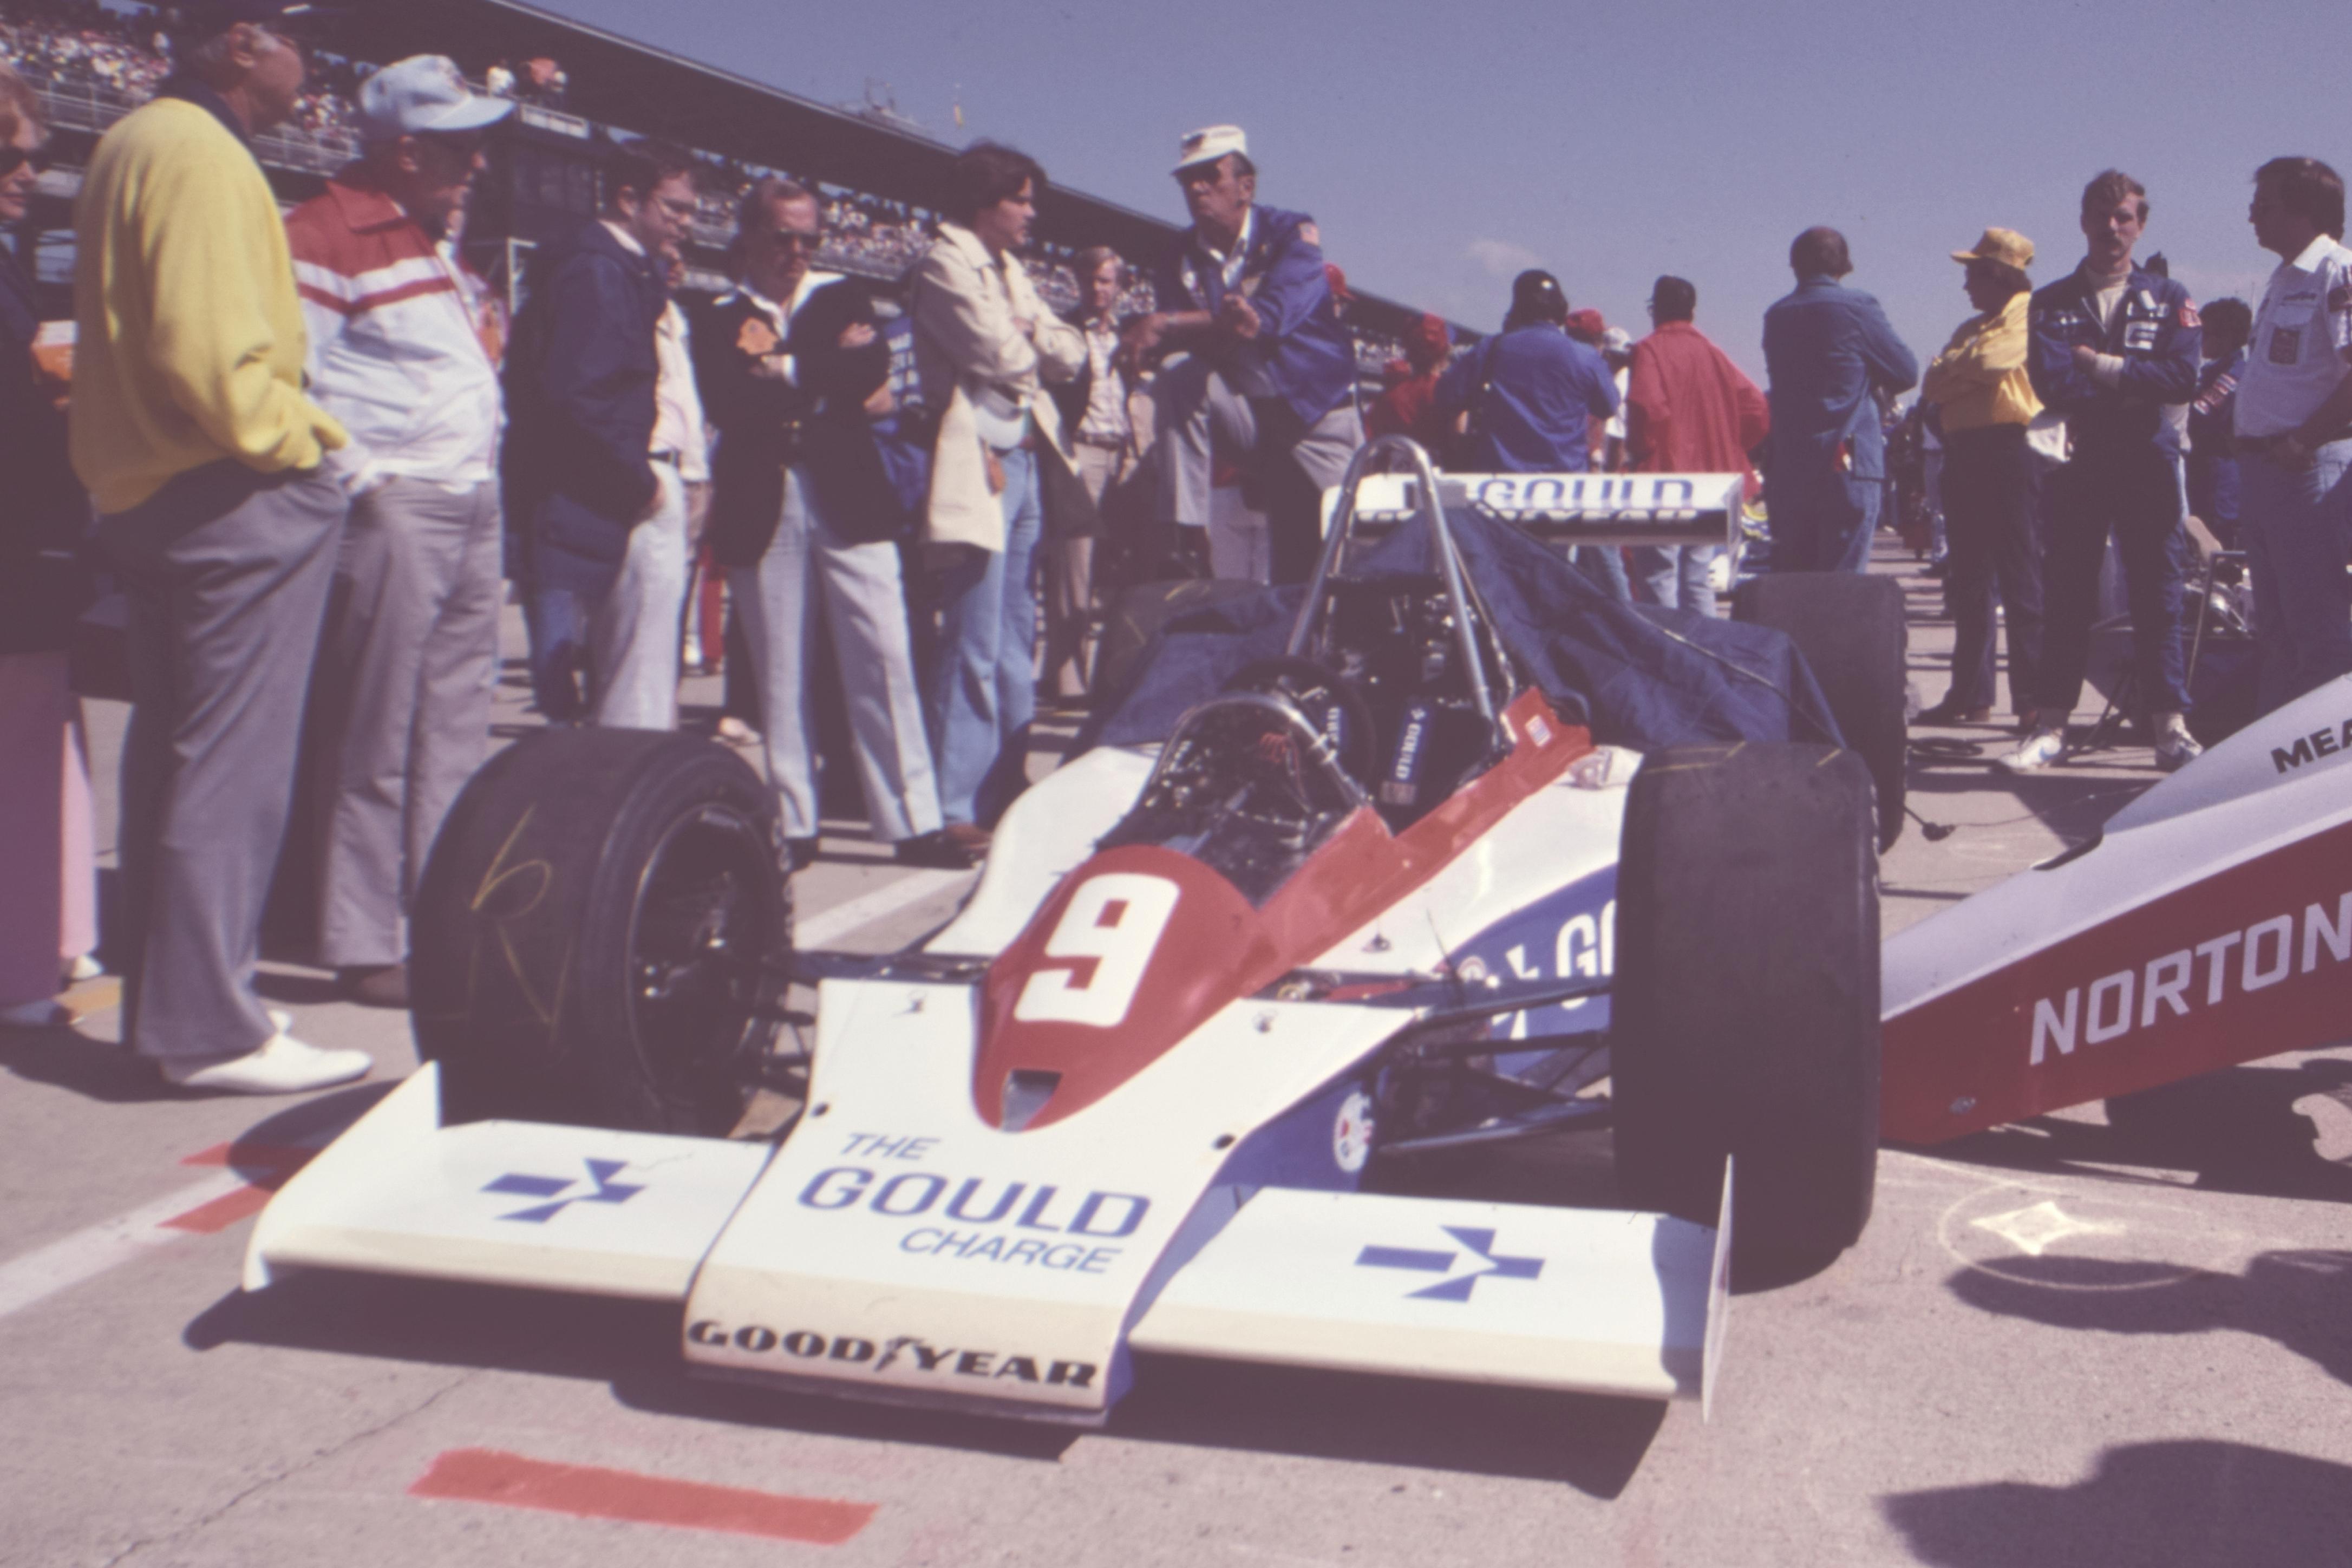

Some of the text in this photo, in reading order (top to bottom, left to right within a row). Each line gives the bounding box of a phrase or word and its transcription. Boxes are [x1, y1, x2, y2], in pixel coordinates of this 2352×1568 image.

[1013, 872, 1182, 1028] 9
[2029, 890, 2352, 1066] NORTON
[840, 1133, 941, 1160] THE
[798, 1166, 1152, 1238] GOULD
[898, 1227, 1122, 1274] CHARGE
[687, 1319, 1098, 1388] GOODYEAR
